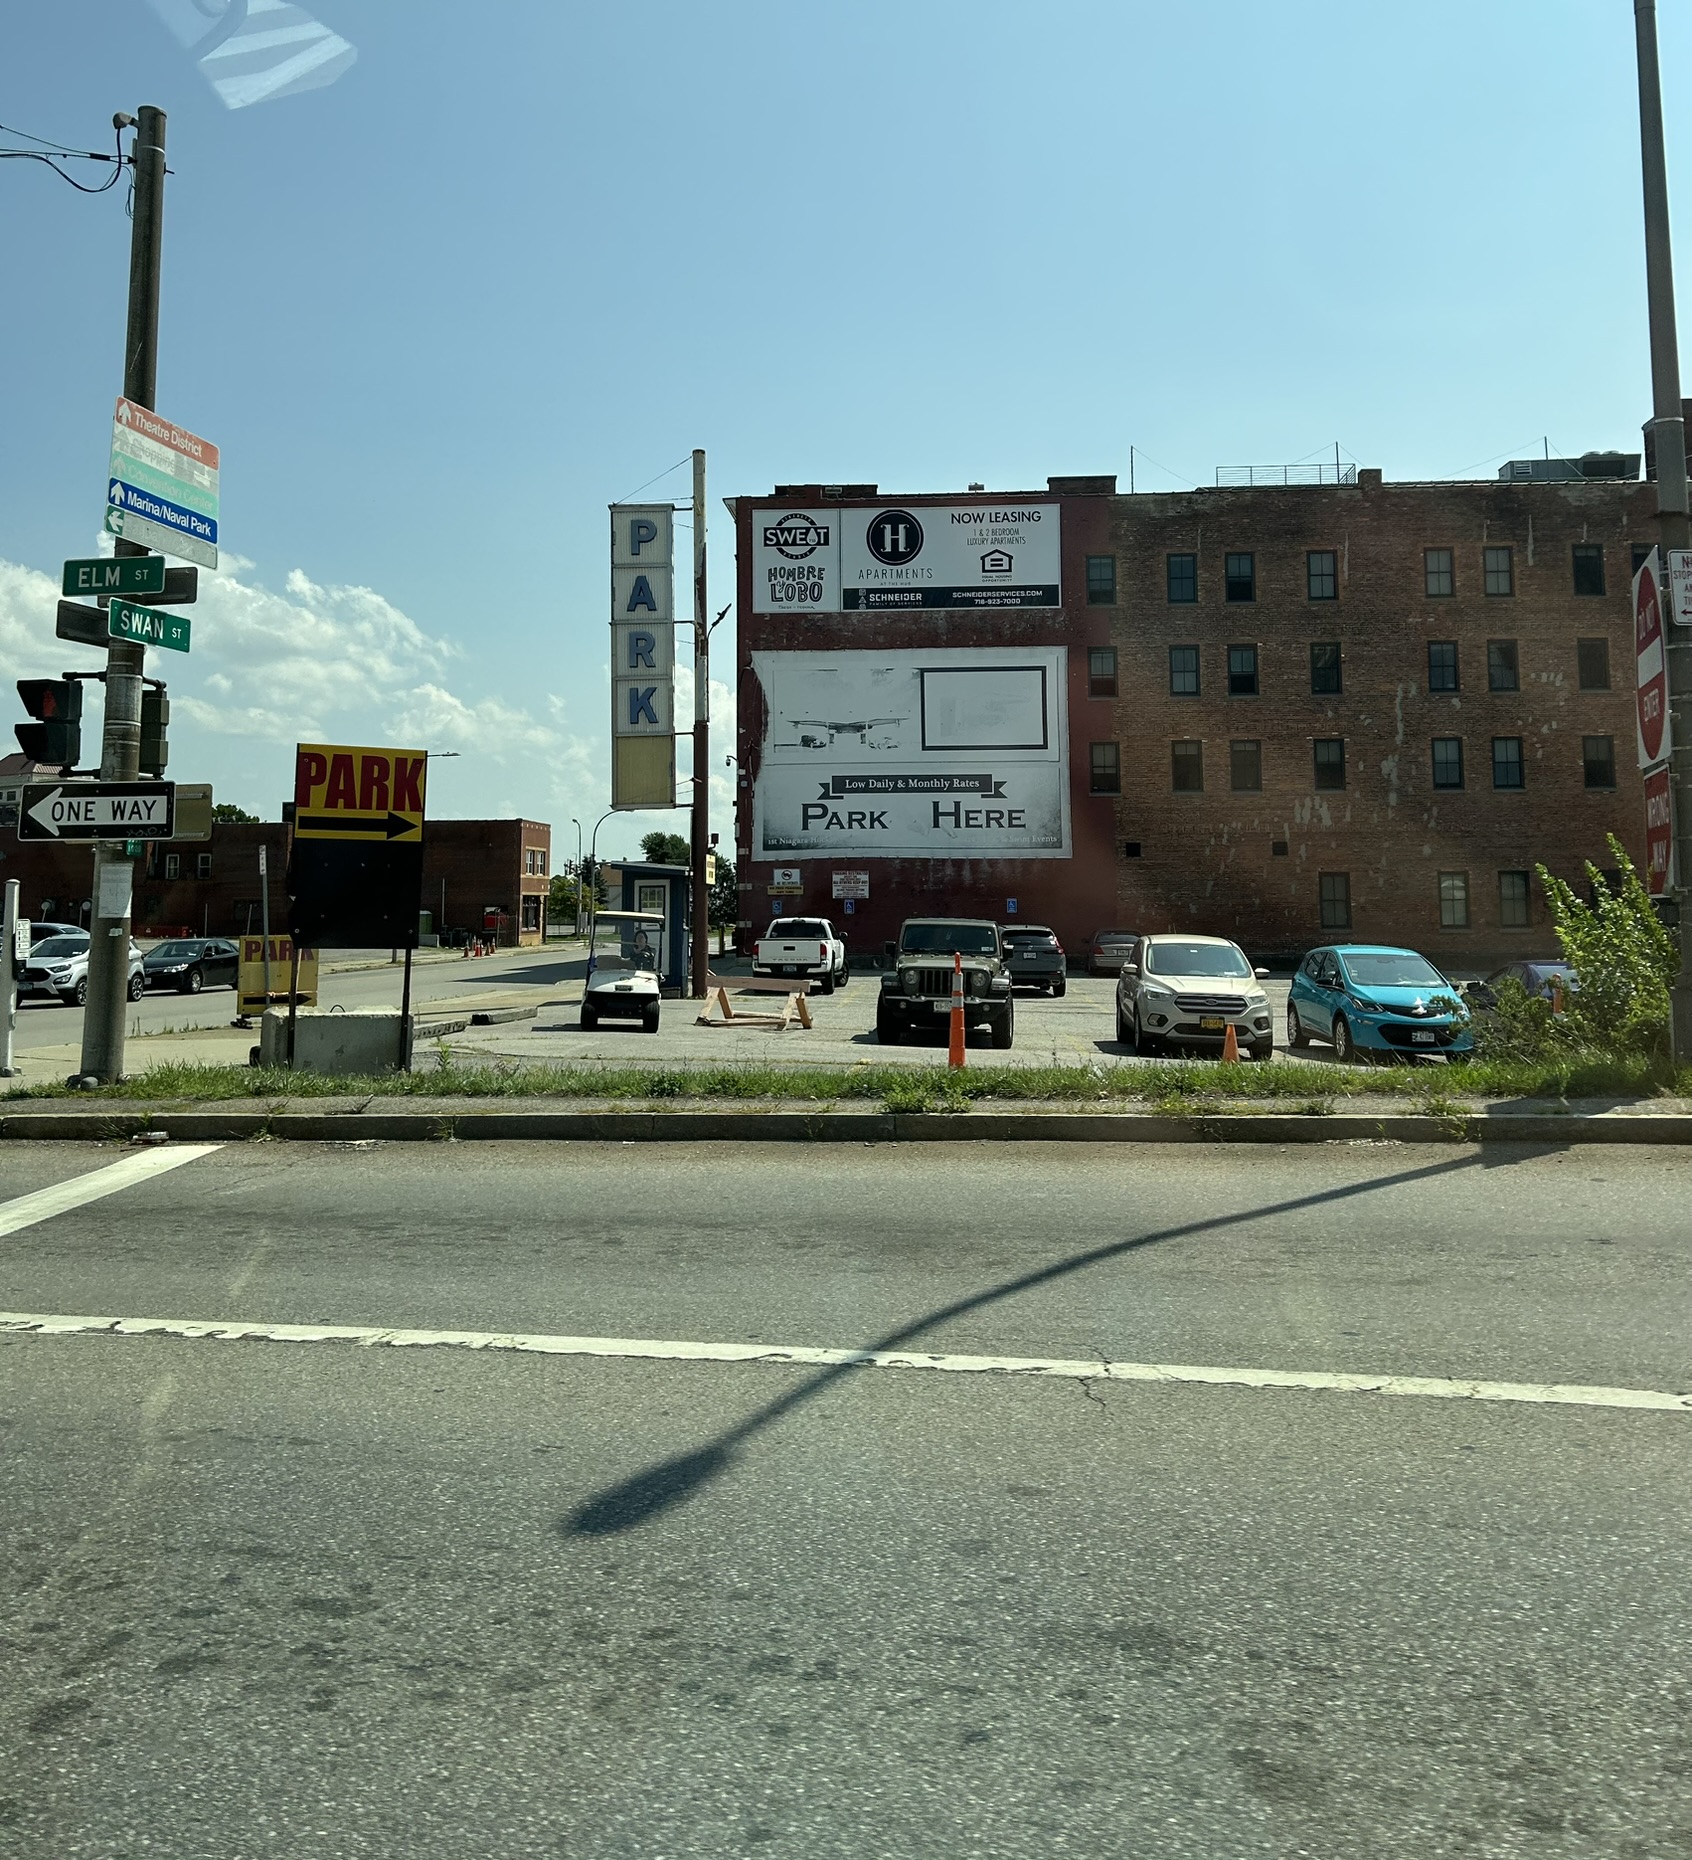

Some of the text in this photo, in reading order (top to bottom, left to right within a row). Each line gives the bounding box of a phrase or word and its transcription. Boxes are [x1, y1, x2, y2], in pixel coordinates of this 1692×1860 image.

[134, 411, 203, 458] Theatre District
[126, 464, 181, 500] Convention
[127, 490, 211, 537] Marina/Naval Park
[951, 510, 1042, 524] NOW LEASING
[880, 523, 910, 553] H
[966, 536, 1026, 546] LUXURY APARTMENTS
[978, 528, 984, 537] &
[985, 528, 990, 536] 2
[991, 527, 1020, 536] BEDROOM
[78, 566, 149, 588] ELM ST
[767, 565, 826, 582] HOMBRE
[858, 567, 933, 580] APARTMENTS
[770, 581, 823, 603] LOBO
[869, 593, 923, 602] SCHNEIDER
[952, 590, 1043, 598] SCHNEIDERSERVICES.COM
[120, 609, 182, 640] SWAN ST
[626, 518, 658, 725] PARK
[297, 752, 424, 813] PARK
[845, 778, 980, 791] Low Daily & Monthly Rates
[51, 800, 157, 822] ONE WAY
[801, 801, 1026, 831] PARK HERE
[1647, 792, 1670, 829] WRONG
[778, 836, 808, 847] Niagara
[1031, 835, 1058, 843] Events
[1652, 840, 1667, 873] WAY
